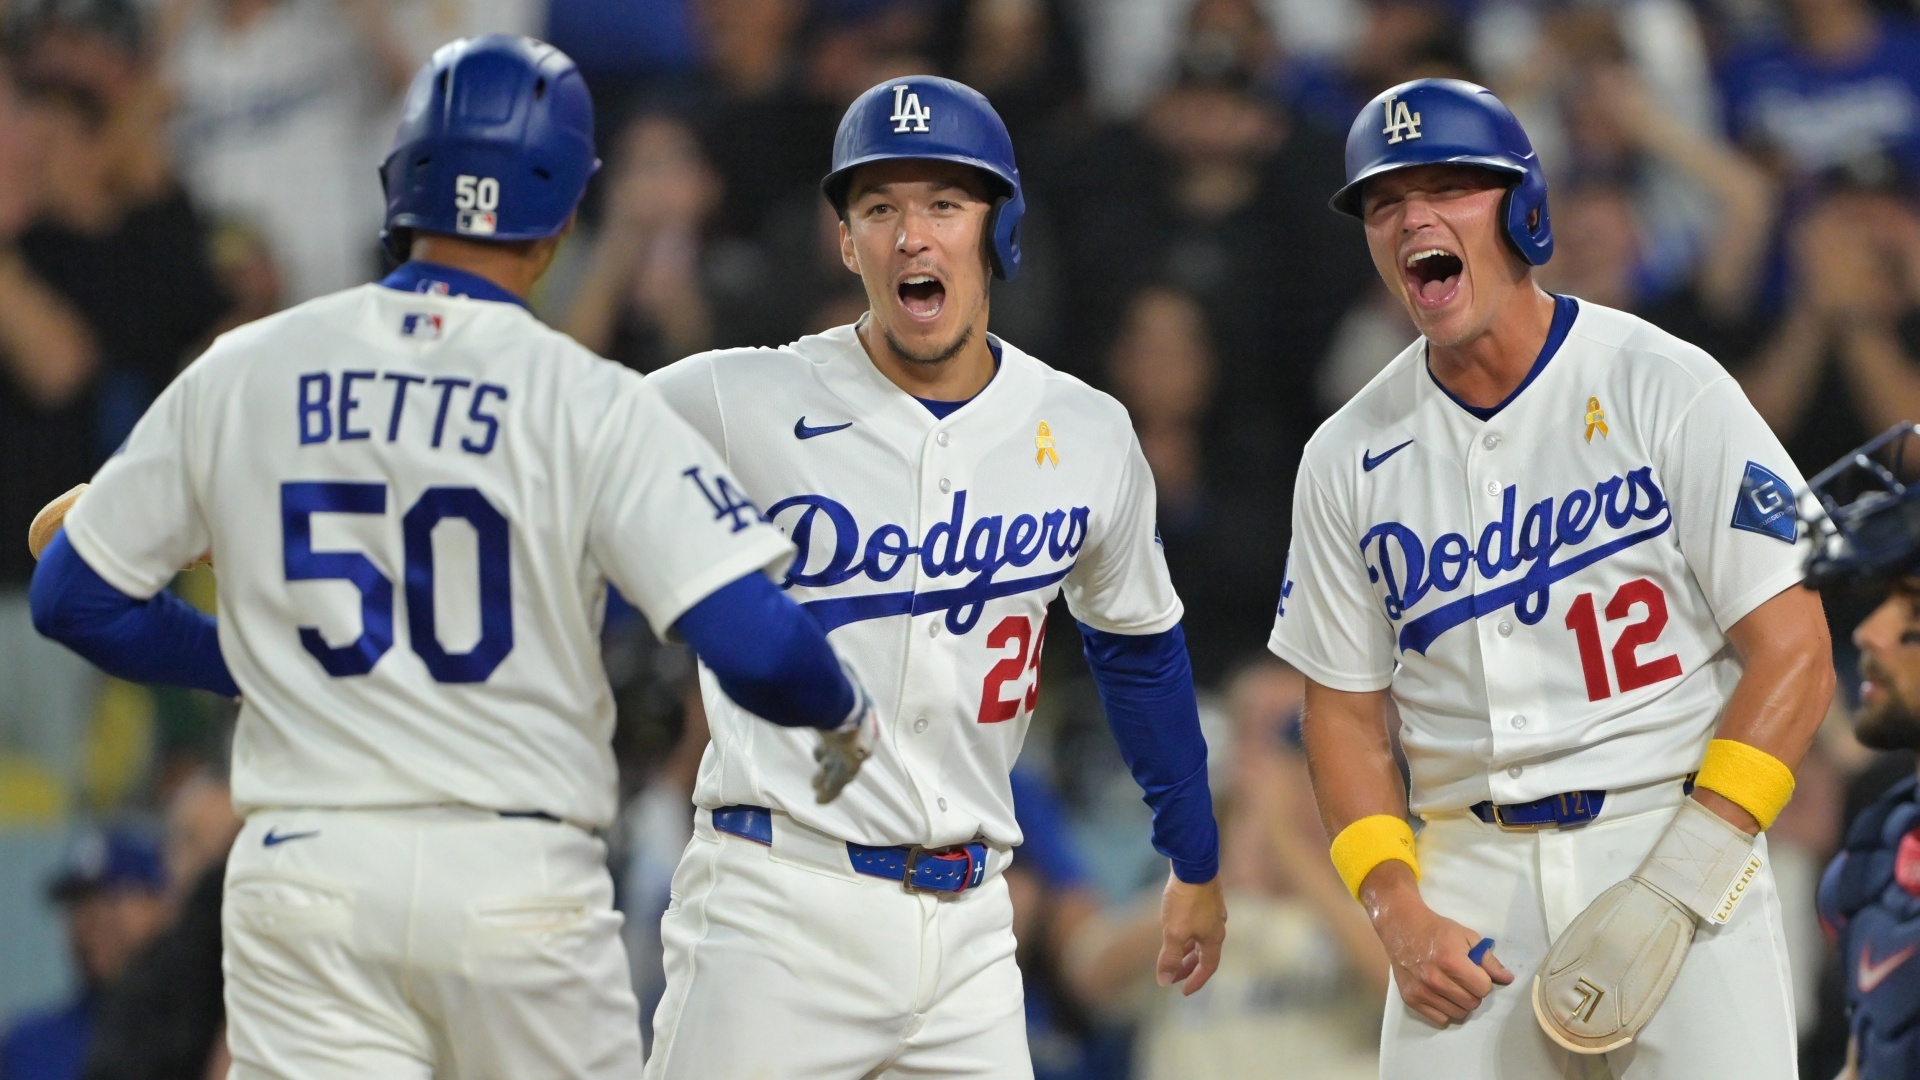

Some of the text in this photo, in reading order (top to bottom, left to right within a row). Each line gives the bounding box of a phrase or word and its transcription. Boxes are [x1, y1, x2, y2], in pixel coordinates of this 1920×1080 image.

[890, 85, 931, 133] LA
[1382, 94, 1422, 145] LA
[455, 174, 500, 211] 50
[299, 370, 508, 455] BETTS
[682, 466, 773, 533] LA
[763, 490, 1089, 634] Dodgers
[1360, 466, 1670, 625] Dodgers
[281, 482, 514, 683] 50
[1565, 578, 1682, 701] 12
[1558, 790, 1584, 816] 12
[1717, 860, 1760, 920] LUCCINI
